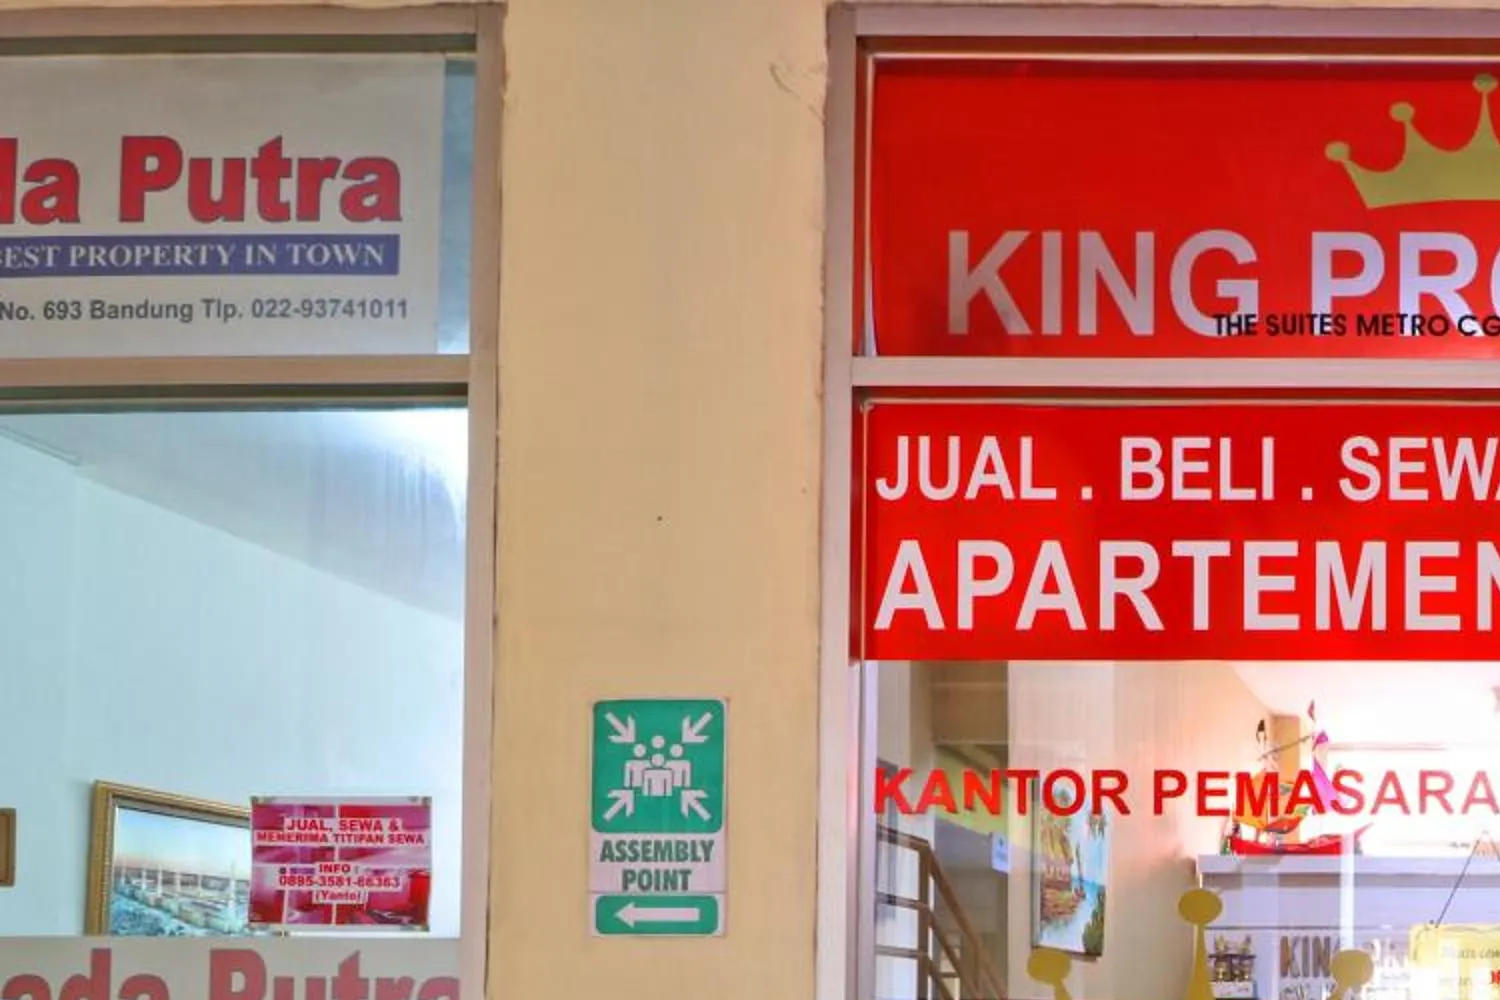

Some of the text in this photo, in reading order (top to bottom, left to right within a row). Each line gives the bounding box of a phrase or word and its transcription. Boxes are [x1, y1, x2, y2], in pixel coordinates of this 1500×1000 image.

[118, 134, 403, 224] Putra
[69, 243, 238, 268] PROPERTY
[244, 242, 278, 266] IN
[286, 242, 386, 267] TOWN
[946, 228, 1261, 340] KING
[0, 300, 36, 321] No.
[43, 299, 83, 321] 693
[89, 299, 194, 323] Bandung
[251, 298, 409, 320] 022-93741011
[1212, 313, 1258, 336] THE
[1265, 313, 1348, 337] SUITES
[1356, 314, 1450, 337] METRO
[875, 434, 1056, 503] JUAL
[1118, 434, 1276, 502] BELI
[872, 768, 1130, 818] KANTOR
[339, 818, 383, 832] SEWA
[256, 832, 425, 845] MENERIMA TITIPAN SEWA
[600, 839, 715, 863] ASSEMBLY
[319, 863, 352, 873] INFO
[621, 868, 692, 892] POINT
